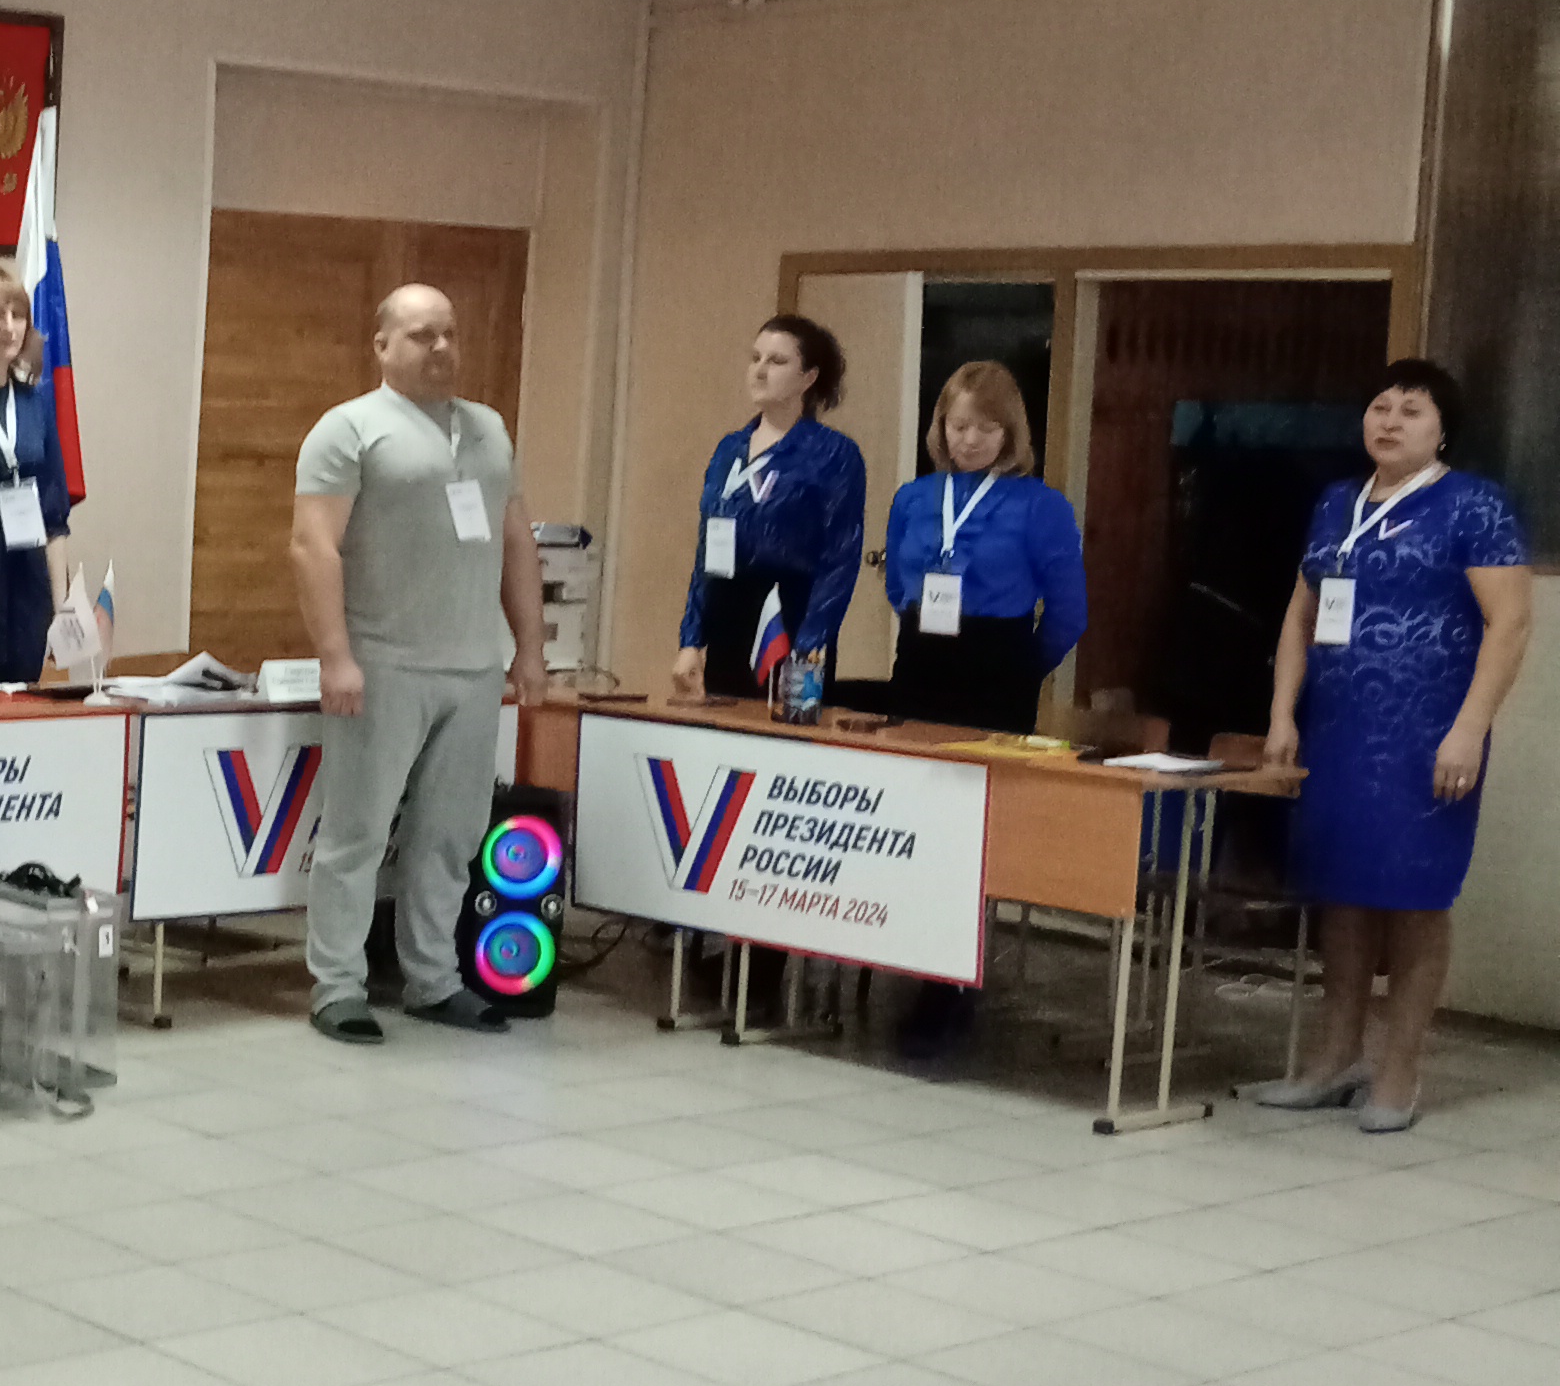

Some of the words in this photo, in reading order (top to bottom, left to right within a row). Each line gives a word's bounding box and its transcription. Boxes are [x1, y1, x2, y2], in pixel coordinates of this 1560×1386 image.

[766, 773, 885, 815] ВЫБОРЫ
[752, 809, 917, 860] ПРЕЗИДЕНТА
[738, 843, 842, 886] РОССИИ
[777, 886, 840, 920] МАРТА
[841, 897, 889, 928] 2024
